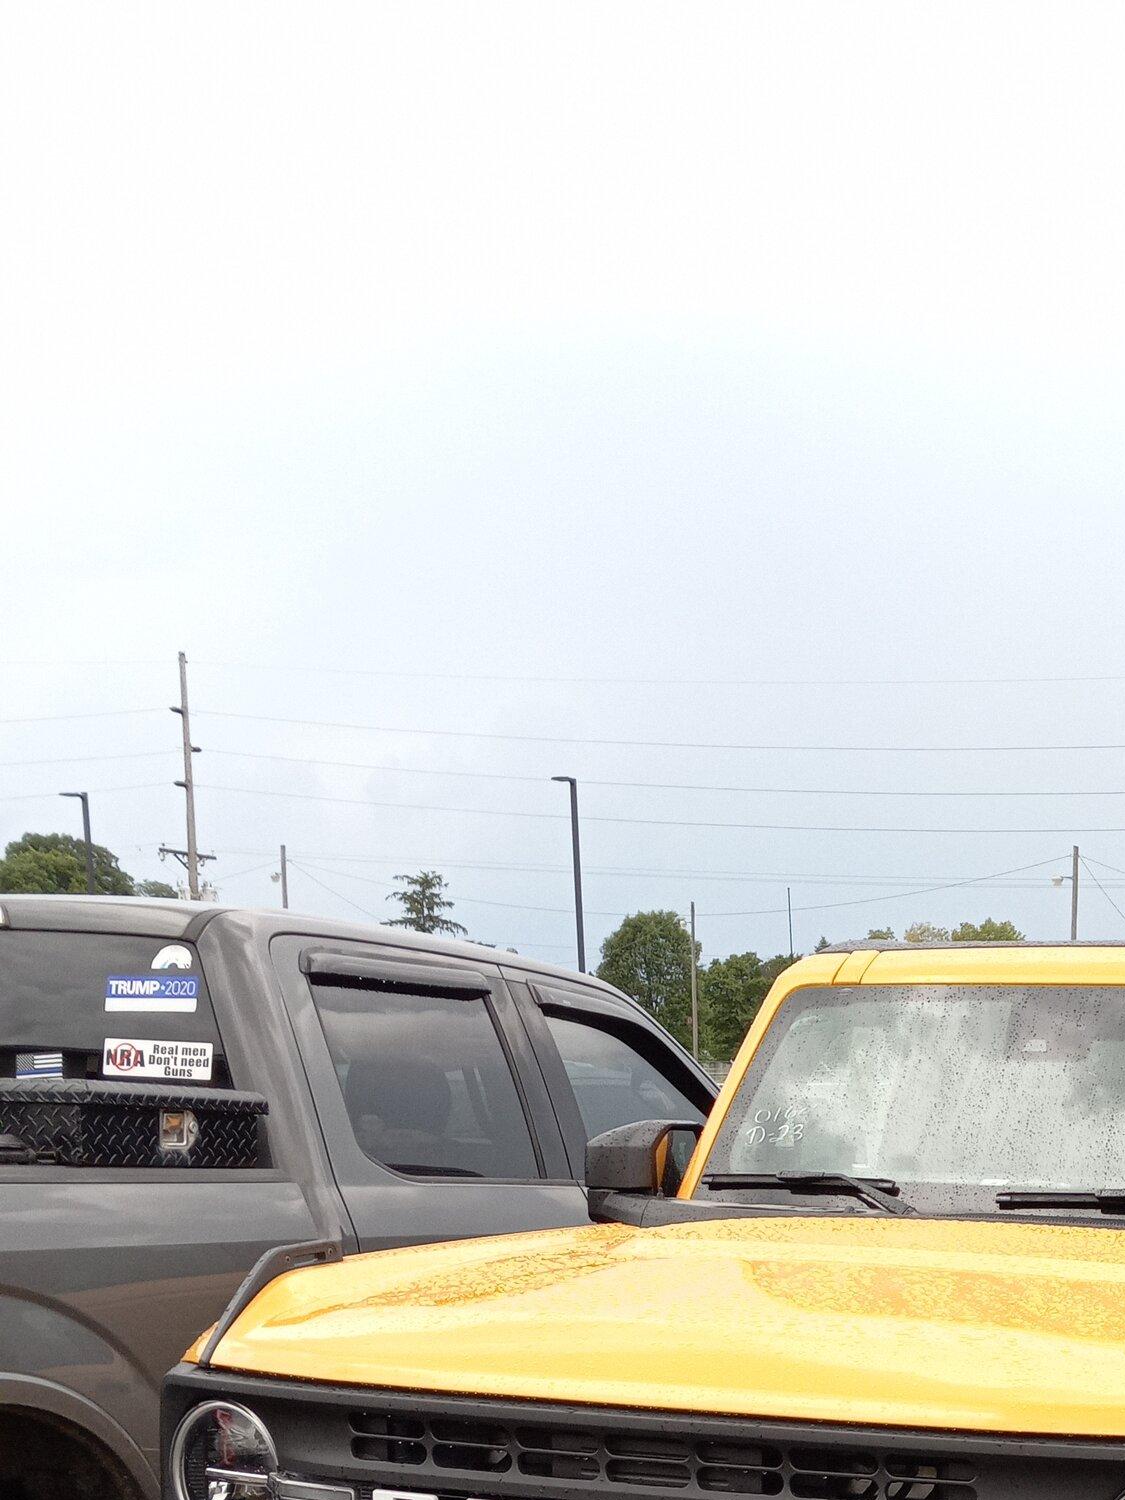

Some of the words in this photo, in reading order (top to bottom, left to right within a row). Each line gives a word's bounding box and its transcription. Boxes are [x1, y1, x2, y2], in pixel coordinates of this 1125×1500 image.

[109, 980, 160, 996] TRUMP
[165, 980, 196, 996] 2020
[106, 1048, 145, 1067] NRA
[153, 1044, 179, 1056] Real
[181, 1046, 207, 1057] men
[148, 1054, 178, 1066] Don't
[180, 1056, 209, 1068] need
[163, 1066, 193, 1078] Guns
